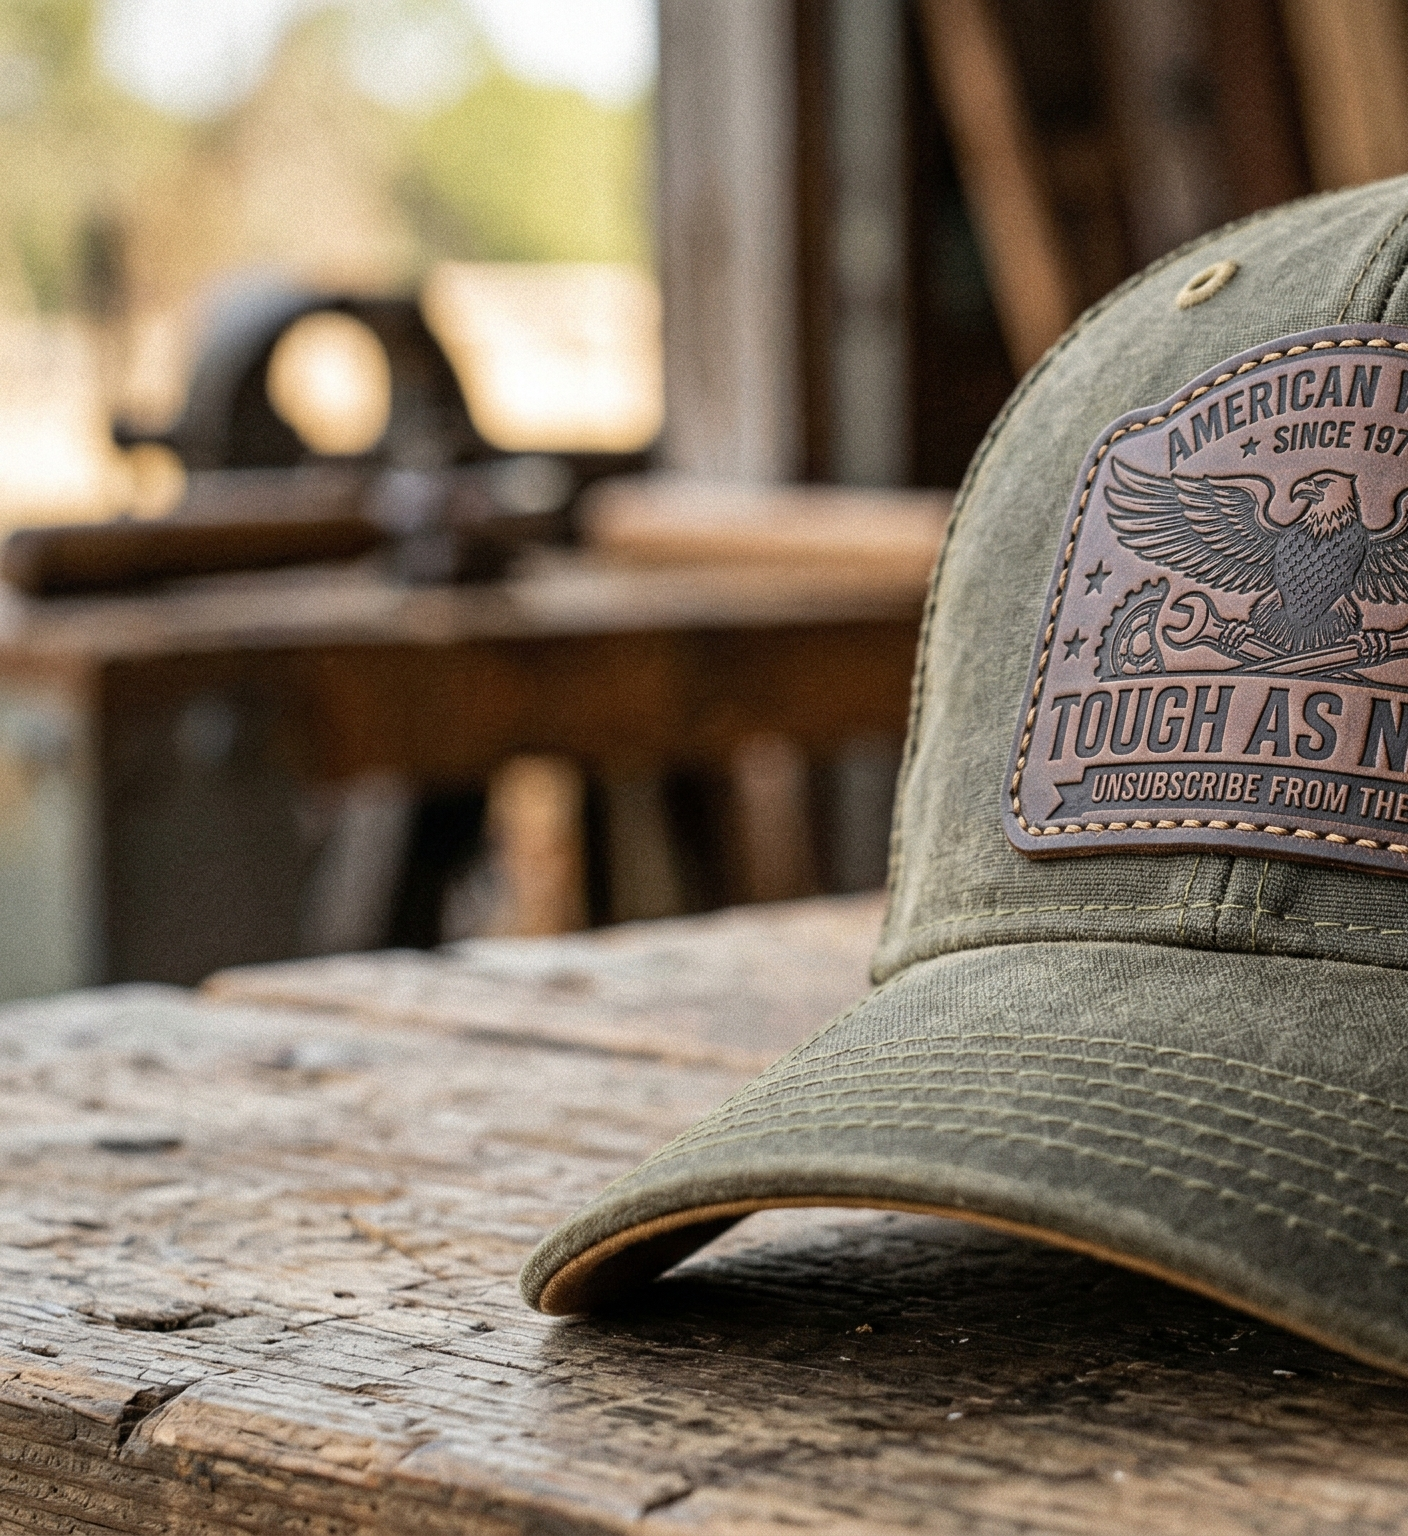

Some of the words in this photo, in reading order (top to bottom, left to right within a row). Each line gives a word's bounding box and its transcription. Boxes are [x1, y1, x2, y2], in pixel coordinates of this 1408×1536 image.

[1168, 364, 1382, 472] AMERICAN
[1273, 421, 1354, 454] SINCE
[1048, 686, 1240, 763] TOUGH
[1245, 690, 1344, 760] AS
[1091, 771, 1259, 805] UNSUBSCRIBE
[1269, 777, 1348, 813] FROM
